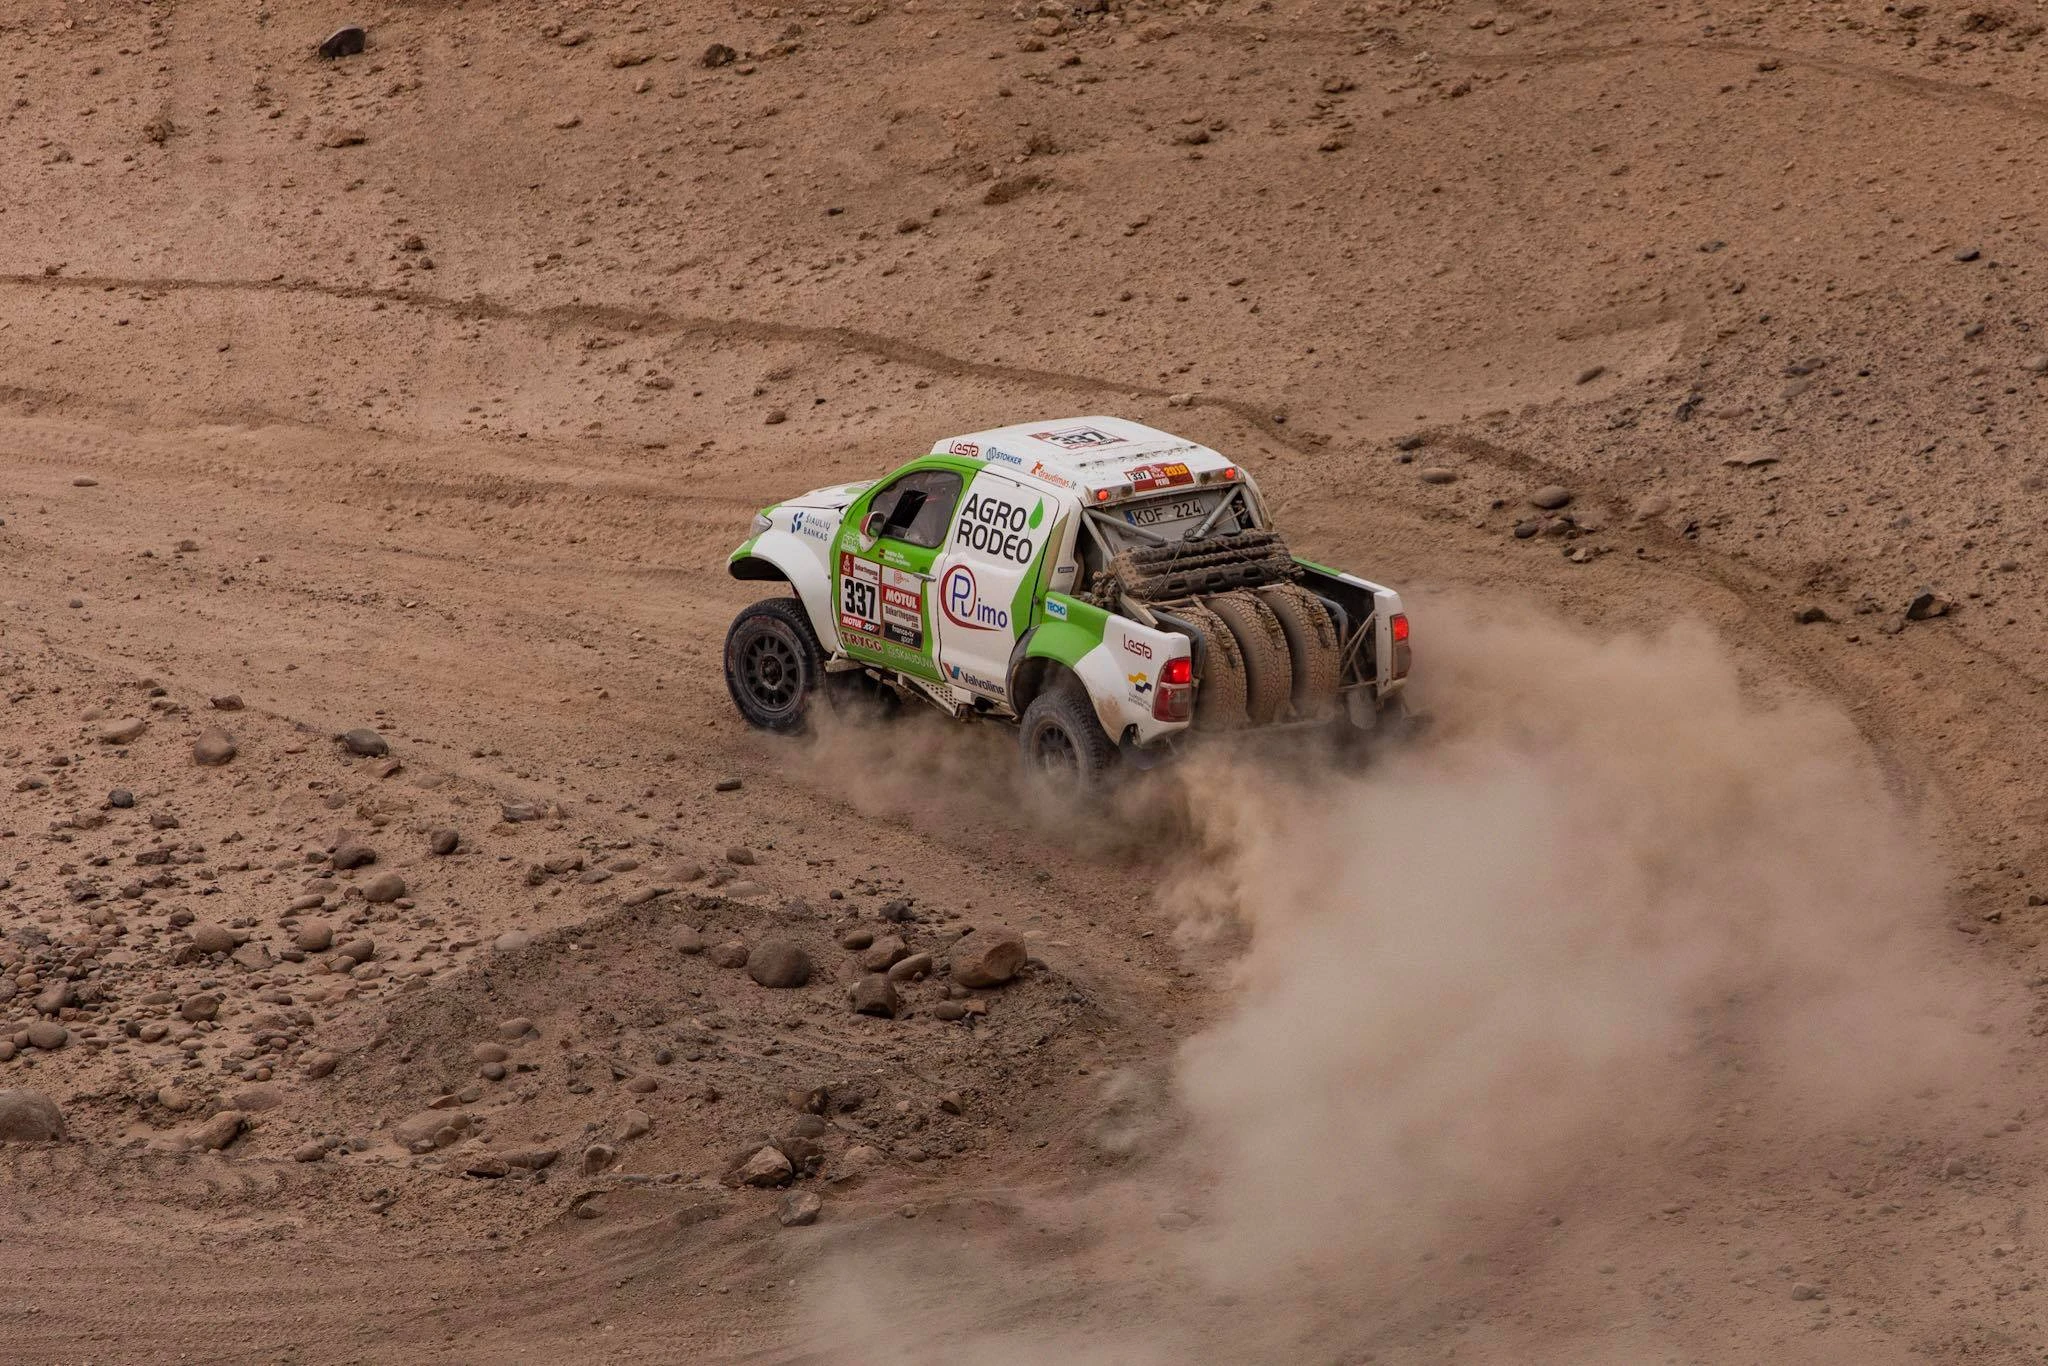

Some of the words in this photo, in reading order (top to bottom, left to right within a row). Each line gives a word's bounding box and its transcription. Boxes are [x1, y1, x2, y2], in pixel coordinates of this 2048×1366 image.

[949, 440, 979, 457] Lesta
[995, 451, 1022, 465] STOKKER
[1130, 471, 1147, 481] 337
[961, 493, 1027, 532] AGRO
[1133, 509, 1163, 526] KDF
[1173, 503, 1201, 518] 224
[803, 527, 829, 542] BANKAS
[957, 518, 1033, 564] RODEO
[844, 578, 876, 620] 337
[885, 588, 917, 609] MOTUL
[842, 616, 862, 628] MOTUL
[1123, 633, 1153, 660] Lesta
[960, 670, 1005, 696] Valvoline
